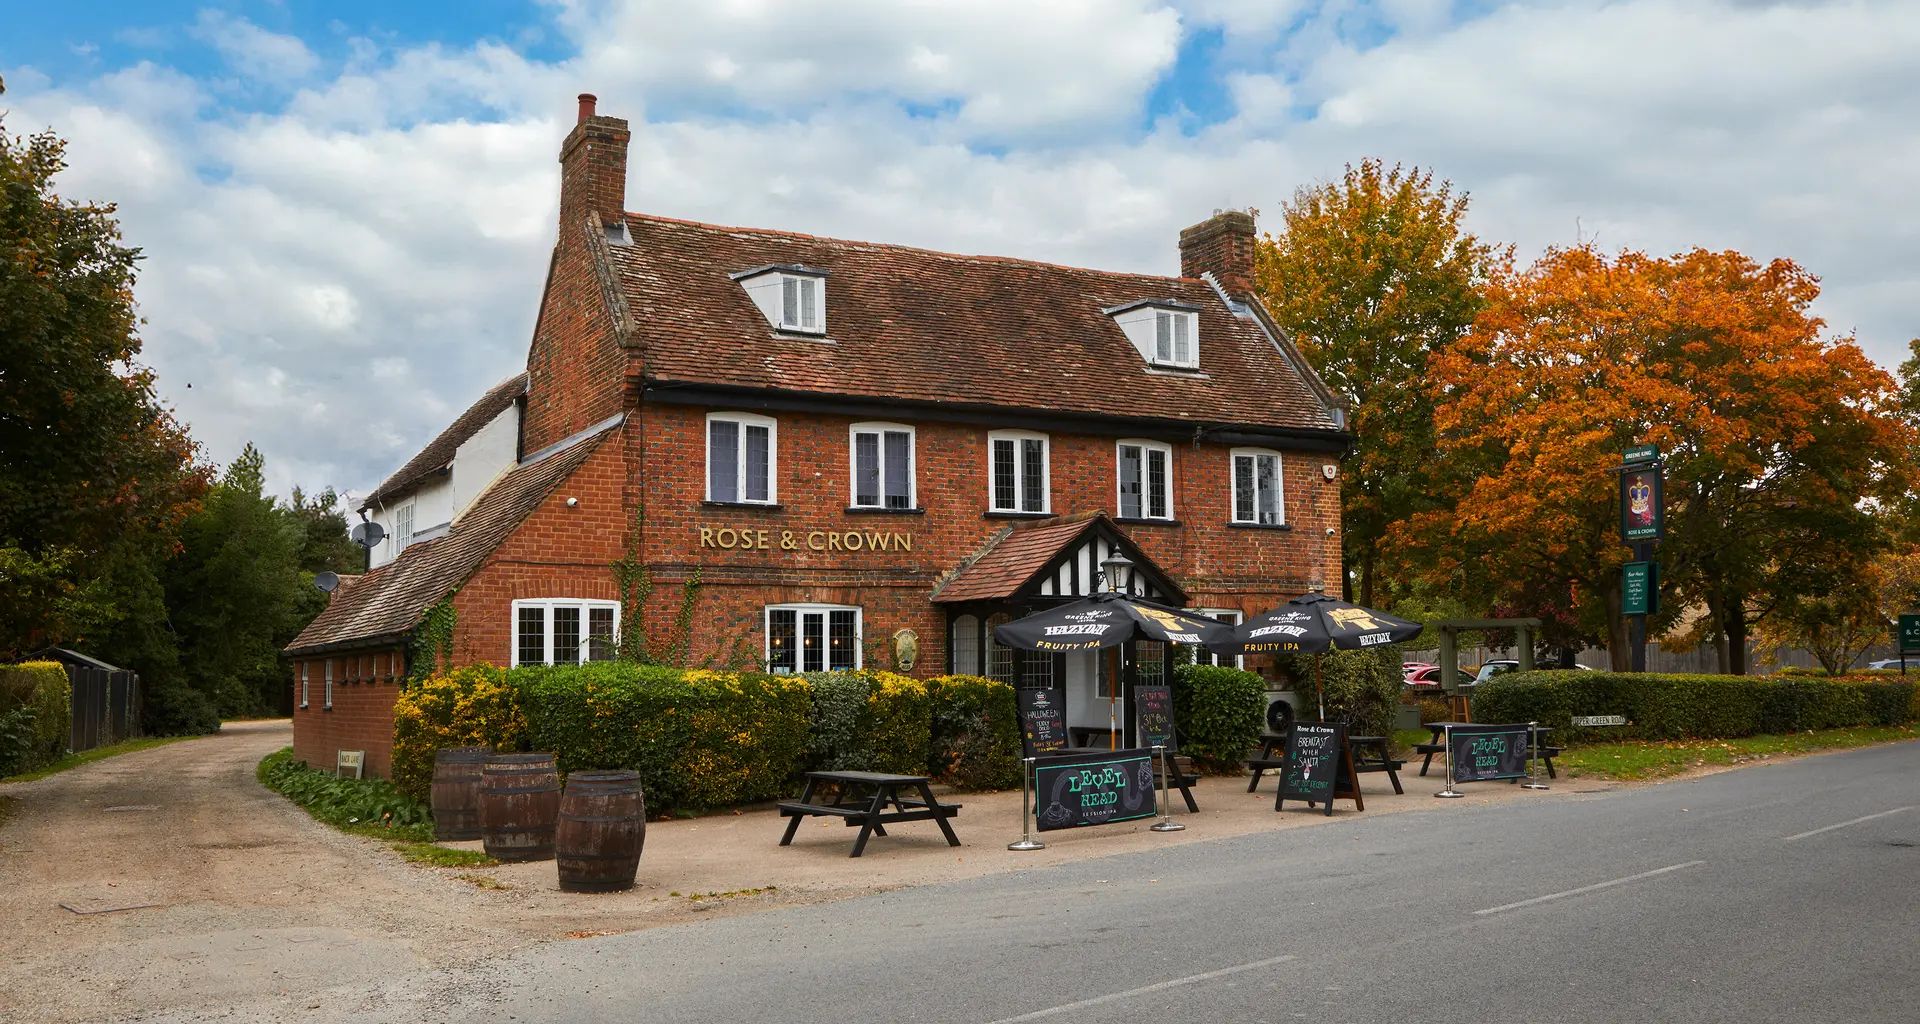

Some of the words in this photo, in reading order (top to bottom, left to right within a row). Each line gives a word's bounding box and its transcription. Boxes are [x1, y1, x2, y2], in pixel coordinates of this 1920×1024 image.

[700, 528, 770, 549] ROSE
[780, 530, 797, 550] &
[807, 531, 912, 551] CROWN
[1036, 640, 1080, 650] FRUITY
[1083, 640, 1100, 649] IPA
[1244, 643, 1280, 652] FRUITY
[1283, 643, 1299, 651] IPA
[1027, 709, 1060, 719] HALLOWEEN
[1591, 717, 1610, 725] GREEN
[1296, 725, 1309, 733] Rose
[1472, 737, 1505, 755] LEVEL
[1475, 755, 1498, 767] HEAD
[1069, 768, 1126, 793] LEVEL
[1080, 791, 1118, 807] HEAD
[1082, 809, 1107, 818] SESSION
